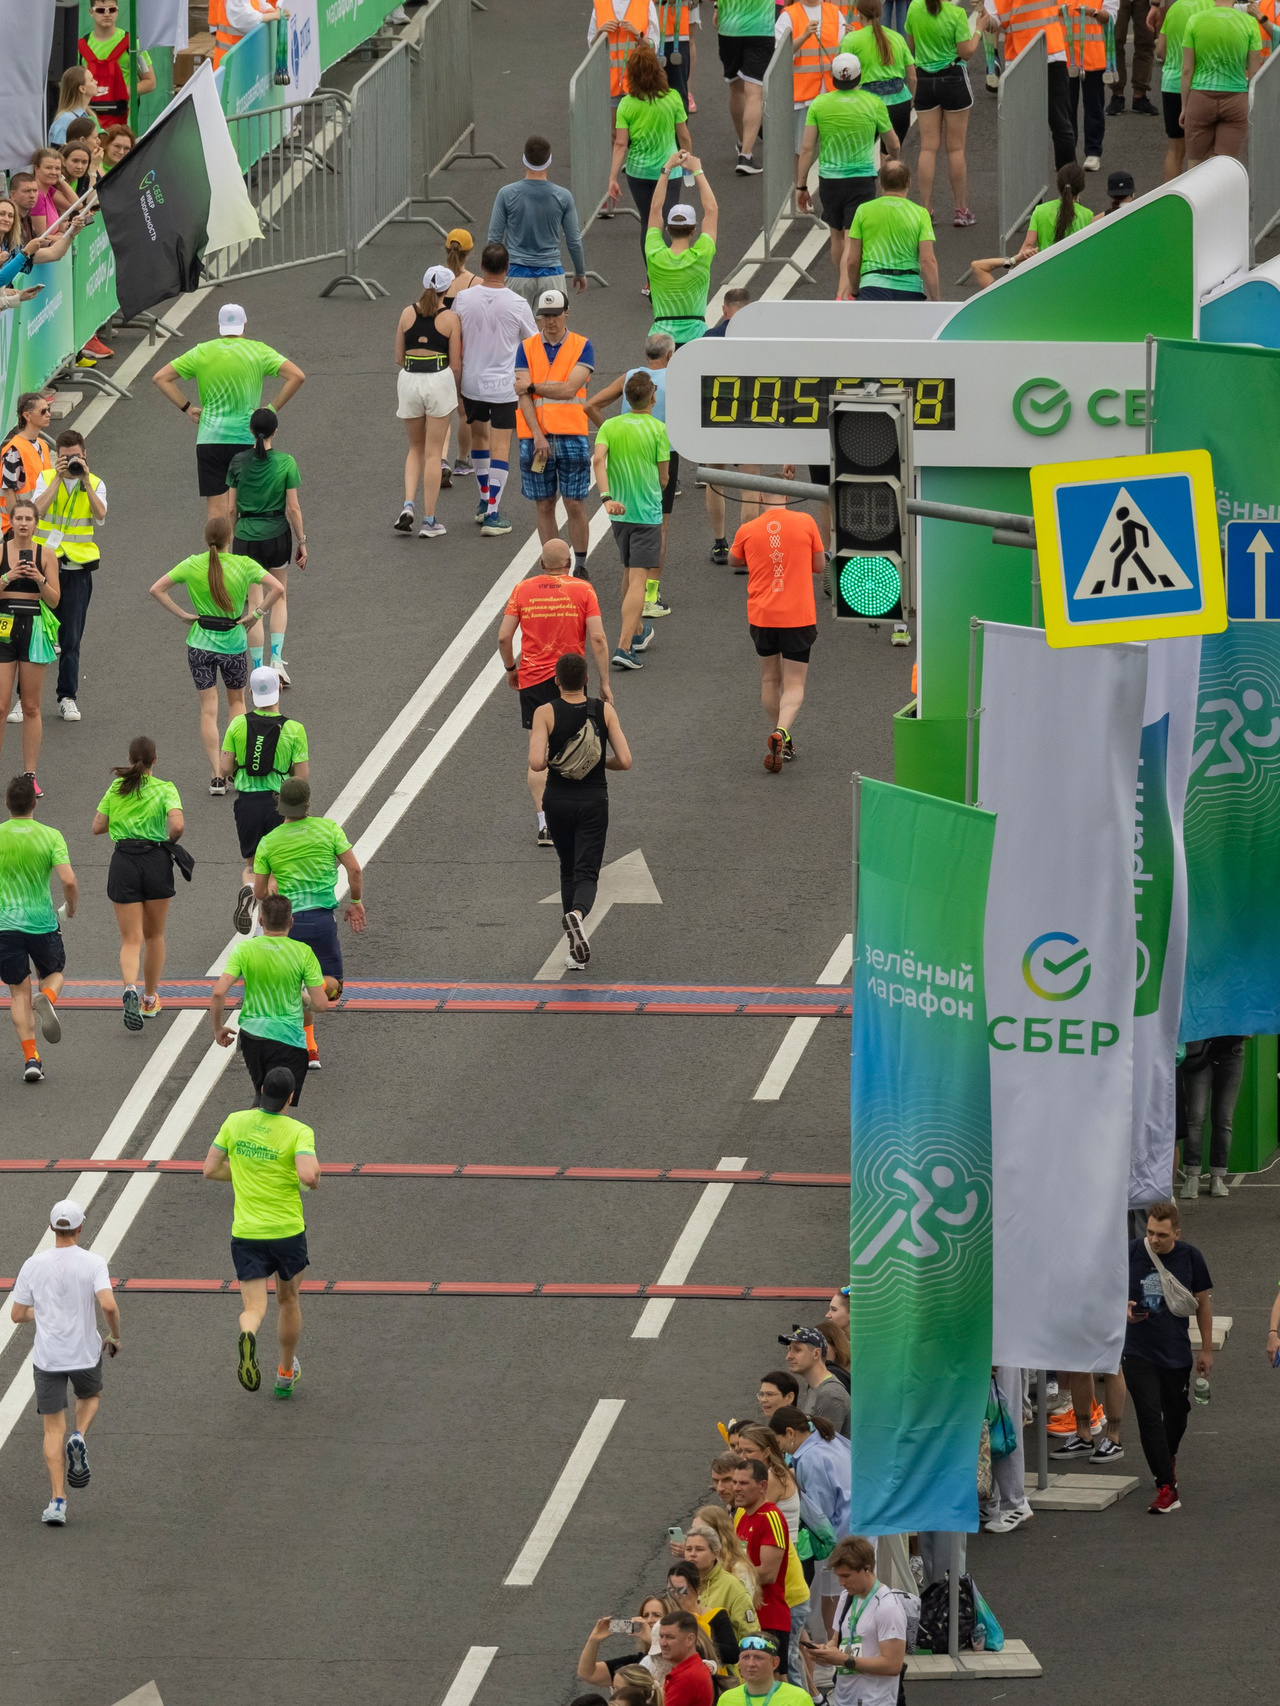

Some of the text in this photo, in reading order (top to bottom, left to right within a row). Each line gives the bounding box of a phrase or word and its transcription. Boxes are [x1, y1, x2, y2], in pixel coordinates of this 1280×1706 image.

[152, 184, 165, 205] СБЕР
[252, 735, 265, 771] INOXTO
[987, 1015, 1121, 1057] СБЕР
